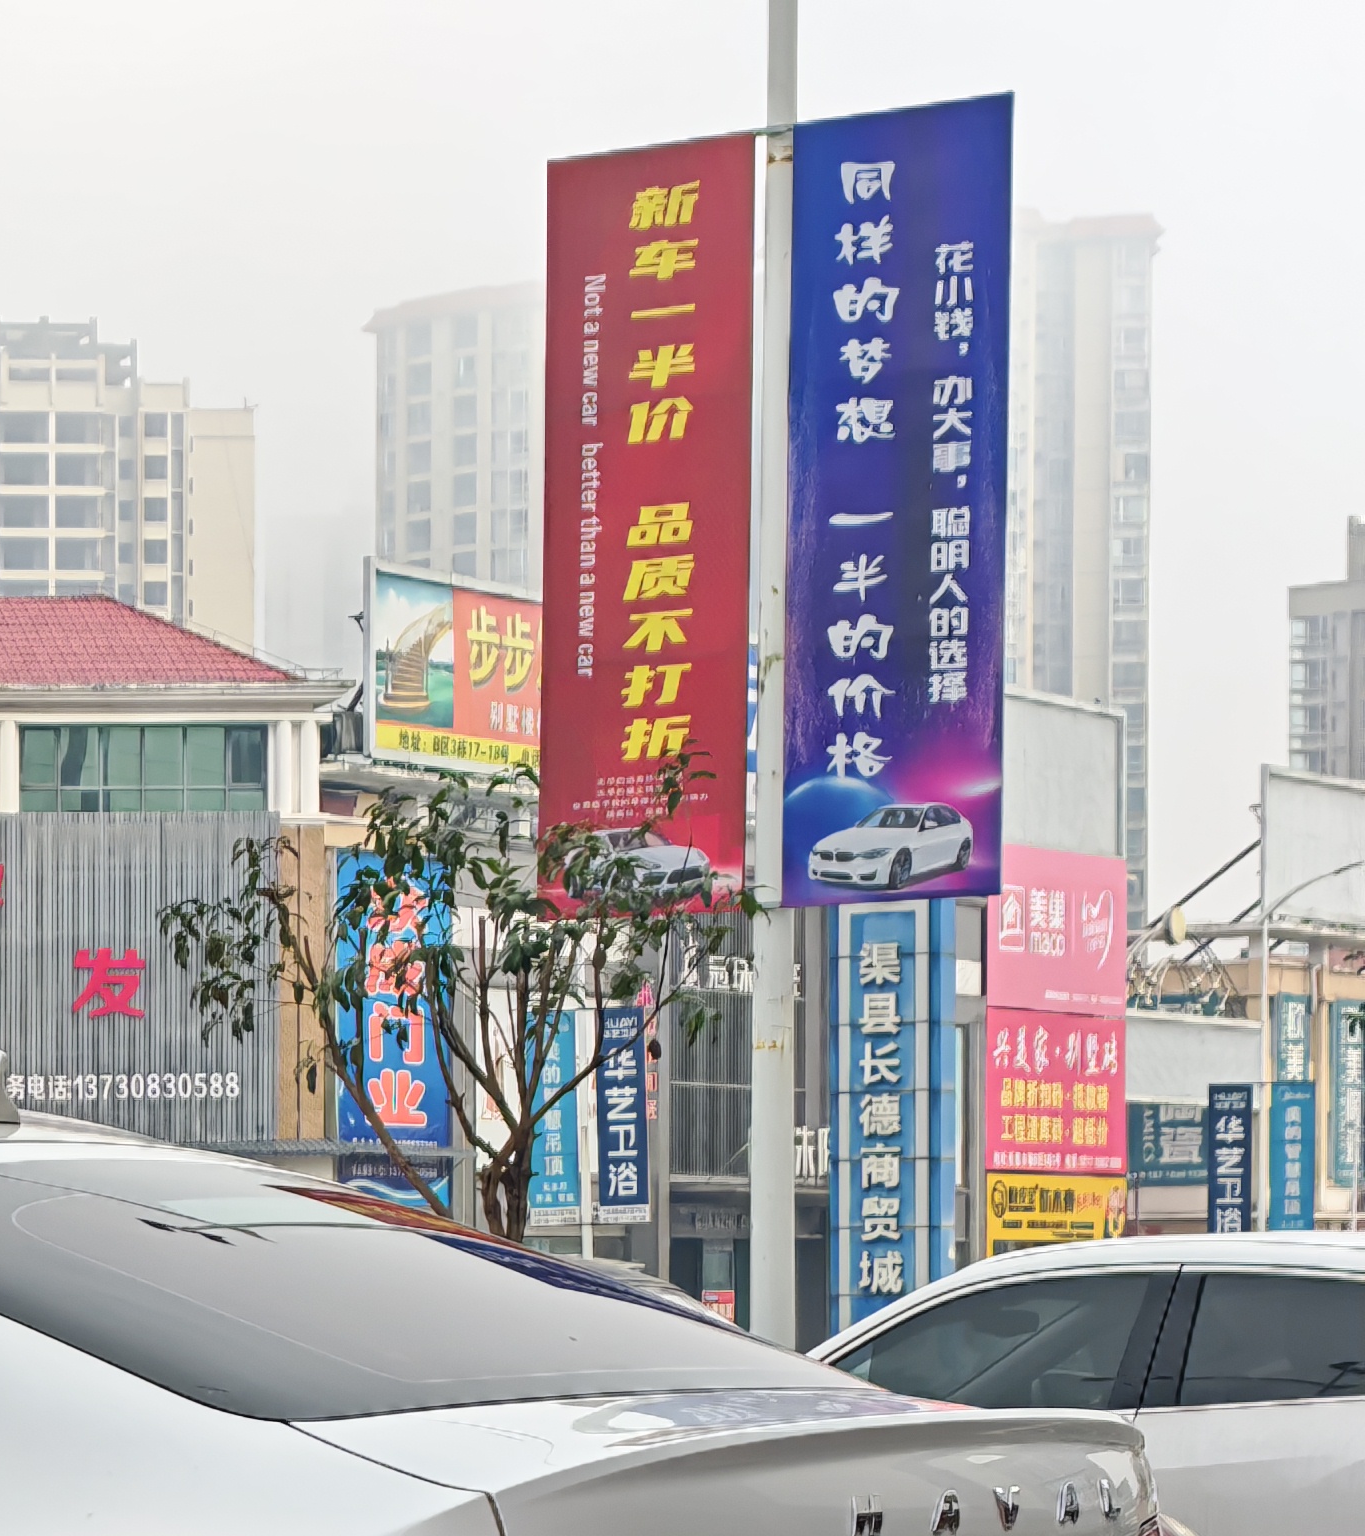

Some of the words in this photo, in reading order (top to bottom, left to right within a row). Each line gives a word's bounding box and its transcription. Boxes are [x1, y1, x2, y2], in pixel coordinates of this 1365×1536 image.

[583, 273, 606, 316] Not
[627, 180, 700, 445] 新车一半价
[832, 161, 900, 443] 同样的梦想
[582, 321, 601, 335] a
[581, 339, 600, 386] new
[580, 392, 599, 427] car
[580, 442, 603, 512] better
[579, 515, 600, 569] than
[578, 573, 595, 588] a
[577, 591, 595, 637] new
[621, 501, 695, 762] 品质不打折
[467, 605, 542, 695] 步步
[576, 643, 594, 677] car
[826, 511, 896, 777] 一半的价格
[489, 701, 541, 737] 别墅楼
[604, 1046, 639, 1197] 华艺卫浴
[858, 942, 905, 1297] 渠县长德商贸城
